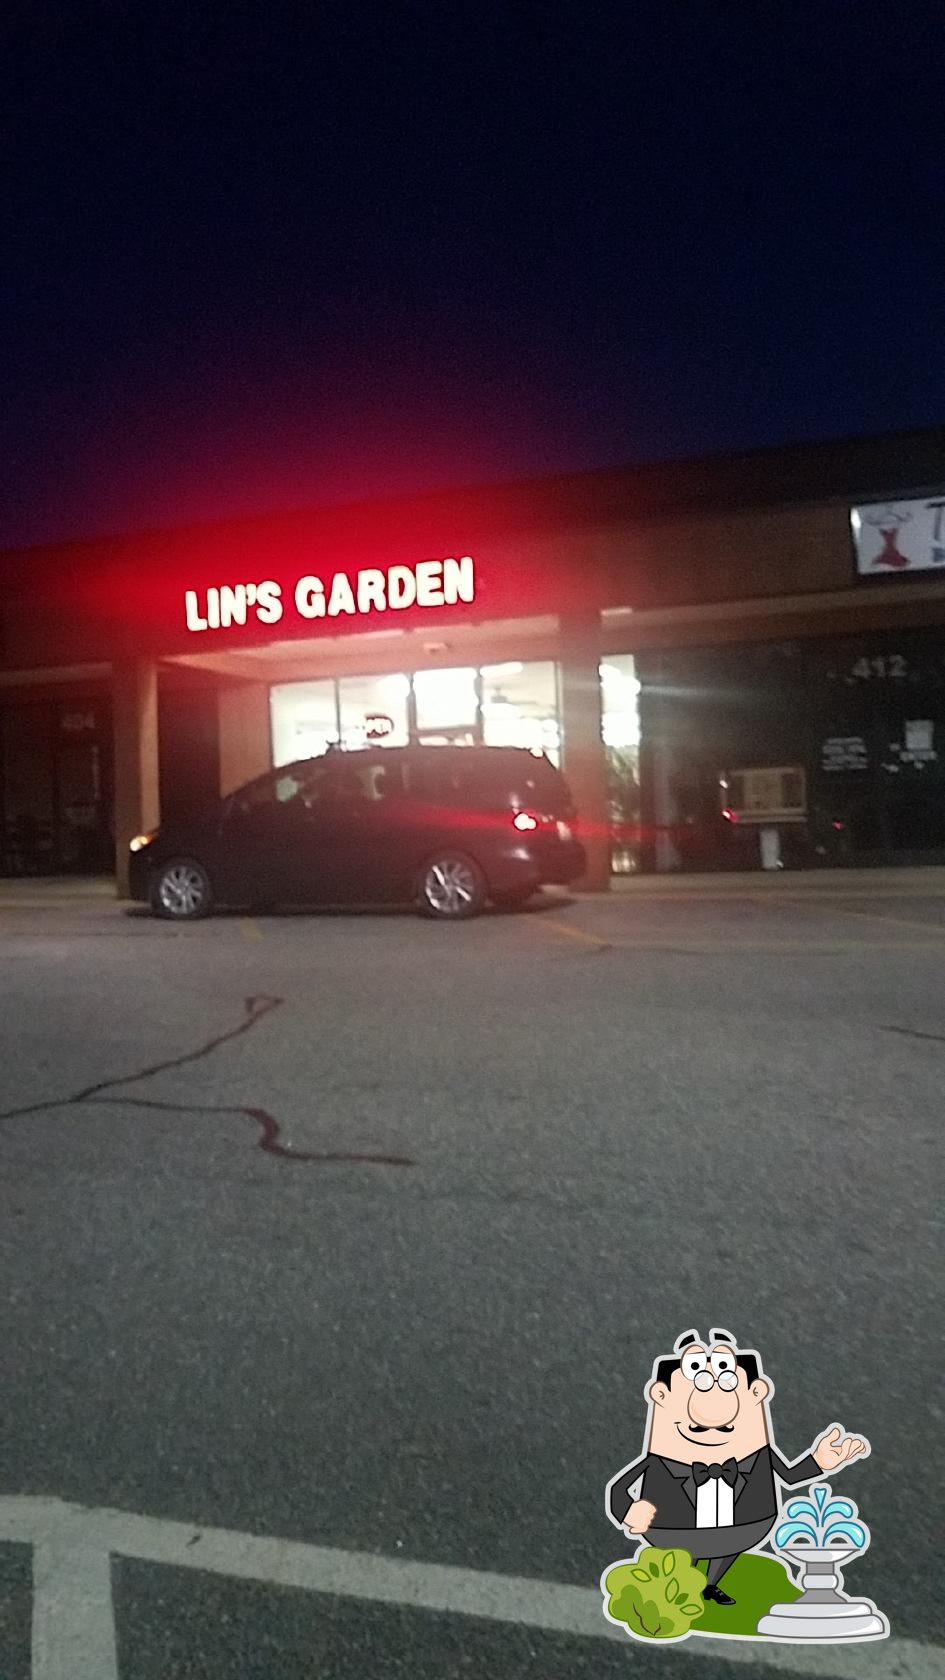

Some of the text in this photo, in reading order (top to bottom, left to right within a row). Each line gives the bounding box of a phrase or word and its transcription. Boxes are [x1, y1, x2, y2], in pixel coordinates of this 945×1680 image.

[185, 556, 474, 632] LIN'S GARDEN
[851, 654, 908, 679] 412
